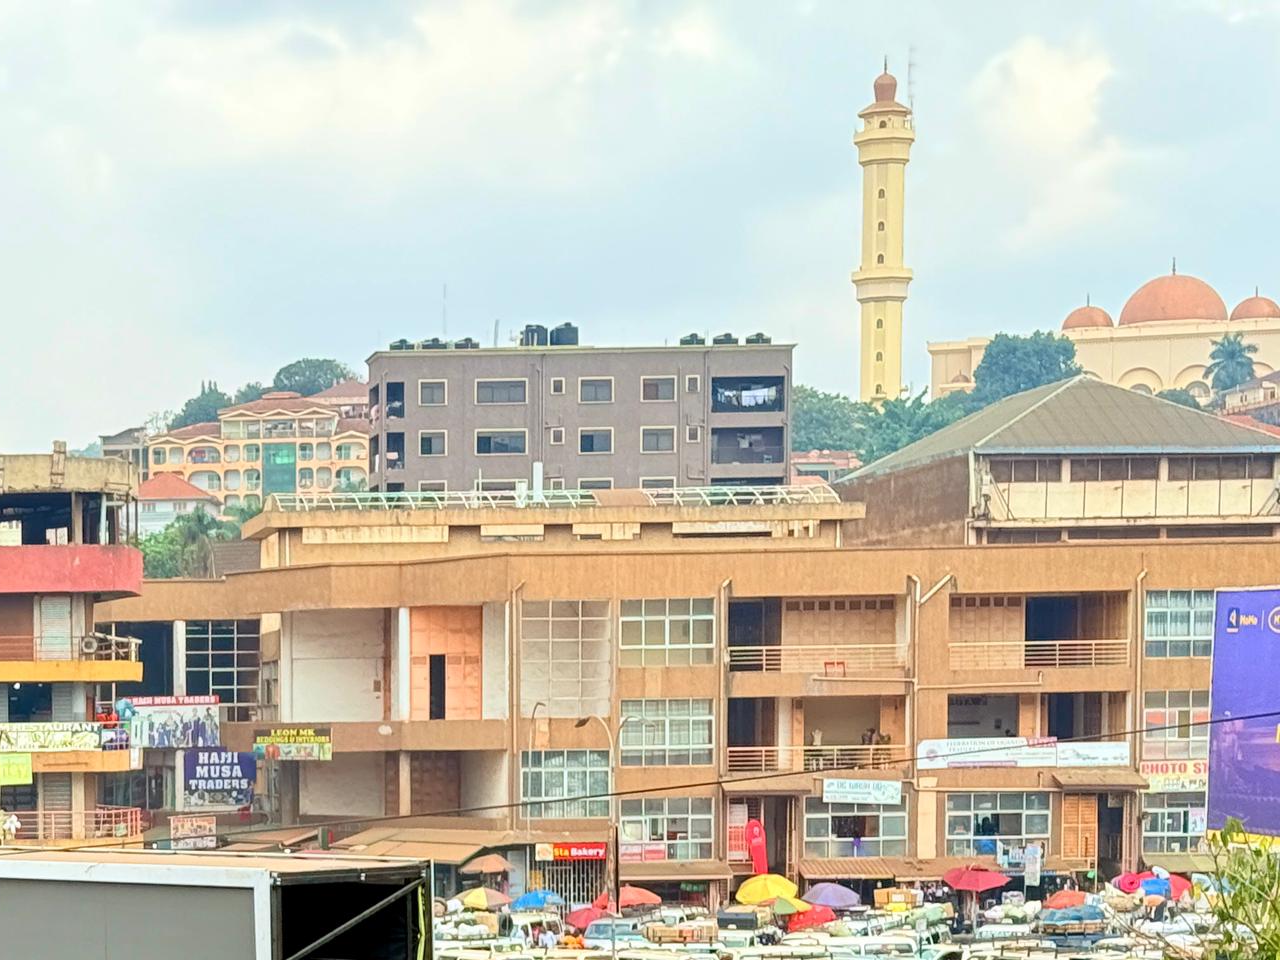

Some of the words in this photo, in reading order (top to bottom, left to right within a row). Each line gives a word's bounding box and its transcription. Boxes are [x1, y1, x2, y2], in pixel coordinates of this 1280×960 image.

[196, 765, 243, 777] MUSA
[1140, 762, 1188, 775] PHOTO
[189, 778, 249, 790] TRADERS
[570, 846, 605, 858] Bakery
